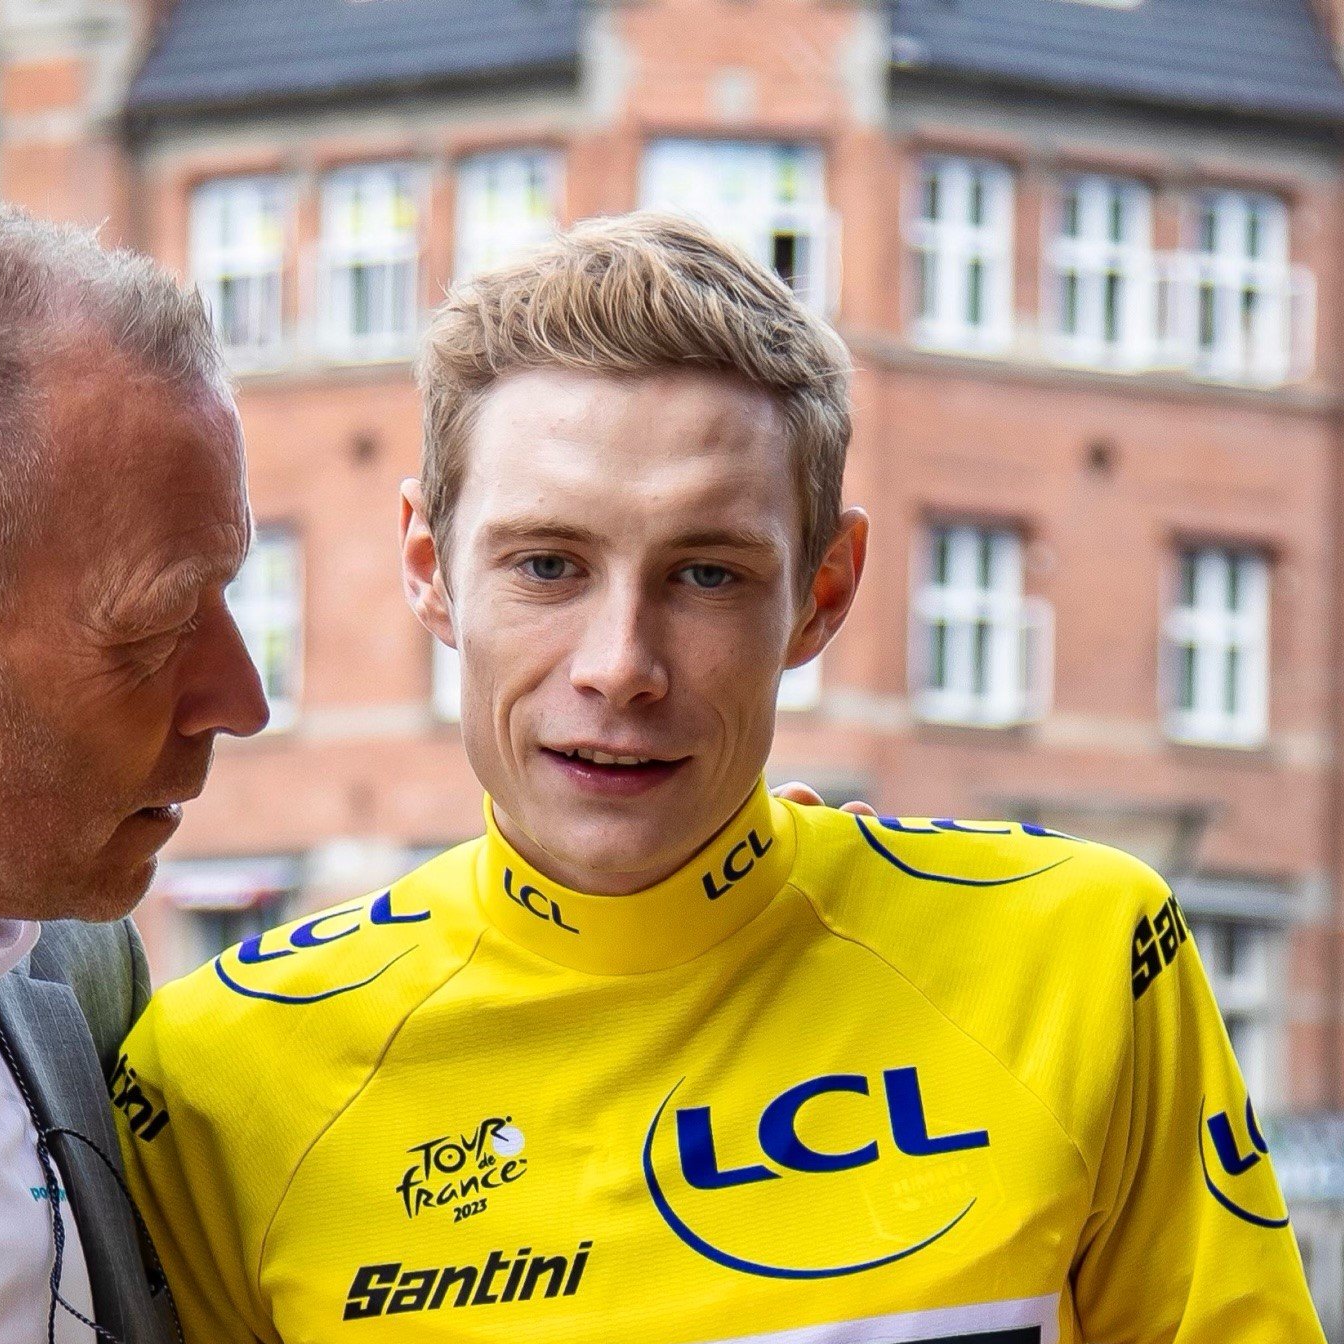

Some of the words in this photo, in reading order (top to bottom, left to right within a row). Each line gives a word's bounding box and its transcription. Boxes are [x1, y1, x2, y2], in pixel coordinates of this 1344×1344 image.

[702, 829, 773, 900] LCL
[238, 890, 431, 964] LCL
[505, 868, 579, 934] LCL
[478, 1152, 497, 1169] de
[675, 1066, 990, 1191] LCL
[453, 1198, 487, 1223] 2023
[342, 1241, 593, 1321] Santini
